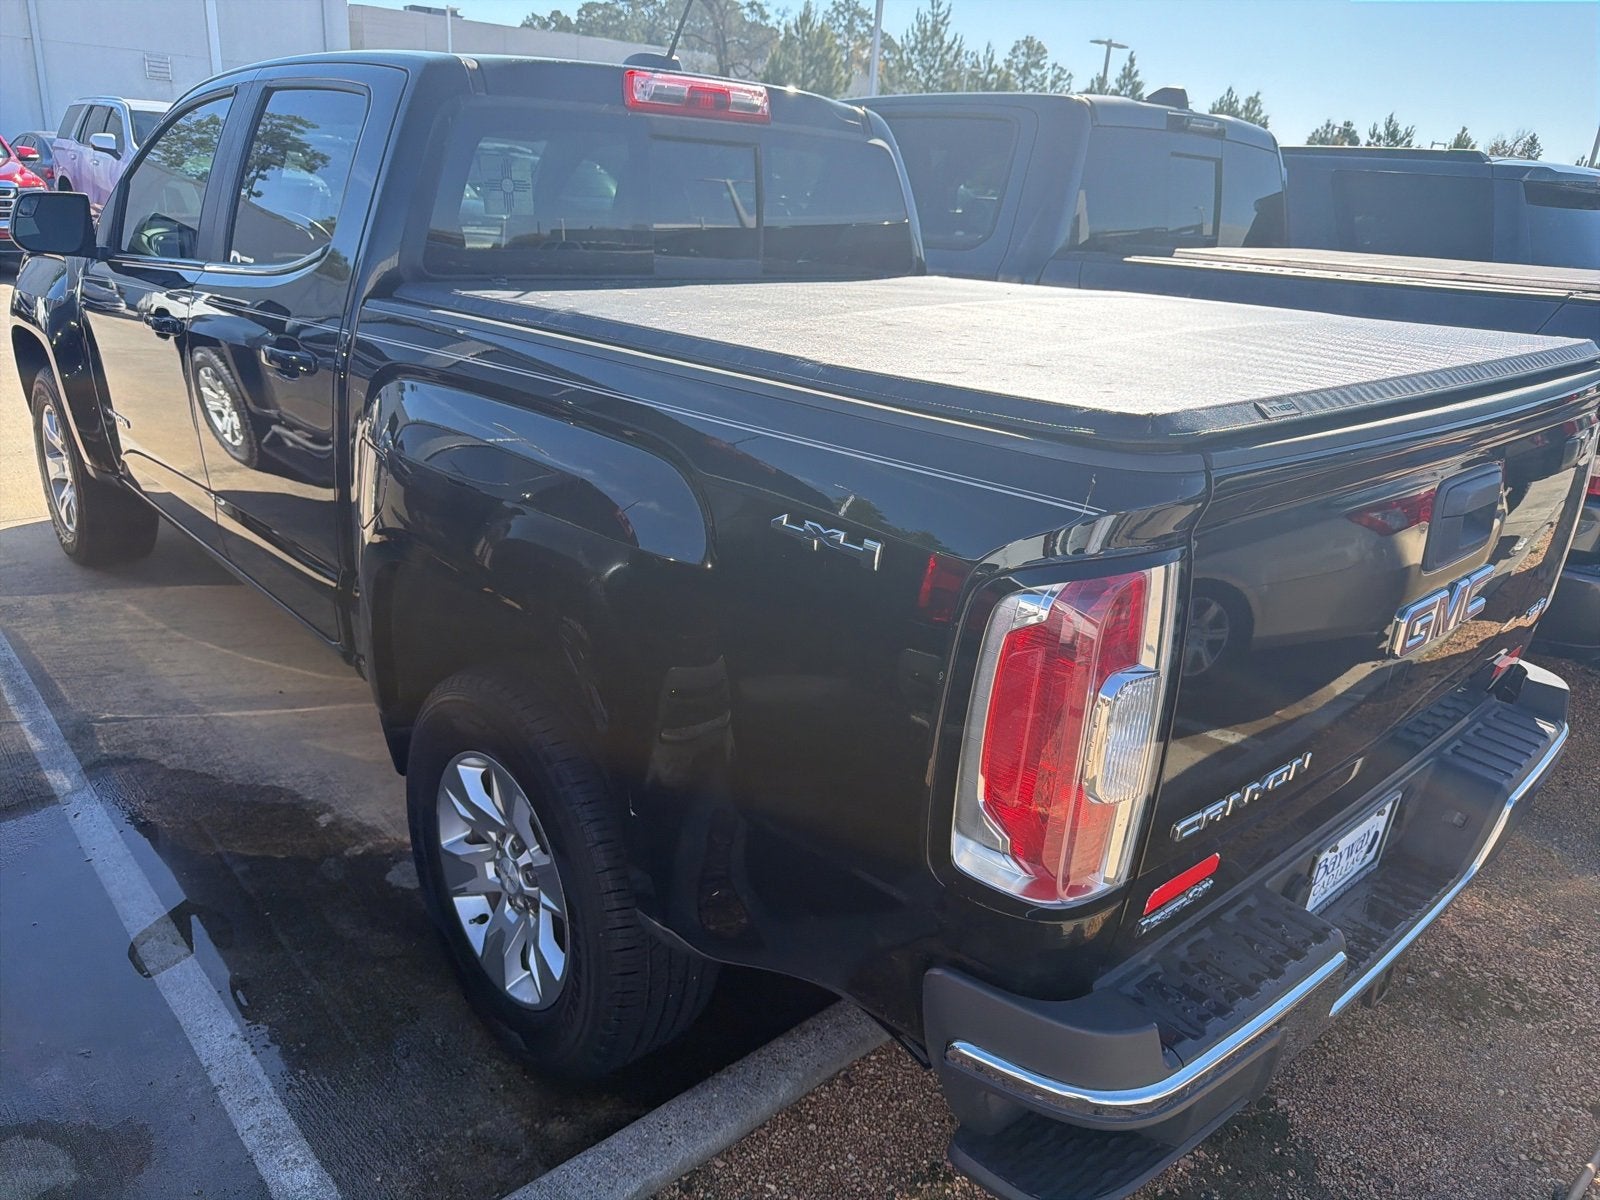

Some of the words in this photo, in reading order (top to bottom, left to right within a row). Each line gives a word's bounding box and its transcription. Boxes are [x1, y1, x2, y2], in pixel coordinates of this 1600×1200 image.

[1389, 563, 1496, 658] GMC
[1170, 751, 1313, 843] CANYON
[1312, 824, 1377, 885] Bayway
[1312, 853, 1367, 897] CADILLAC
